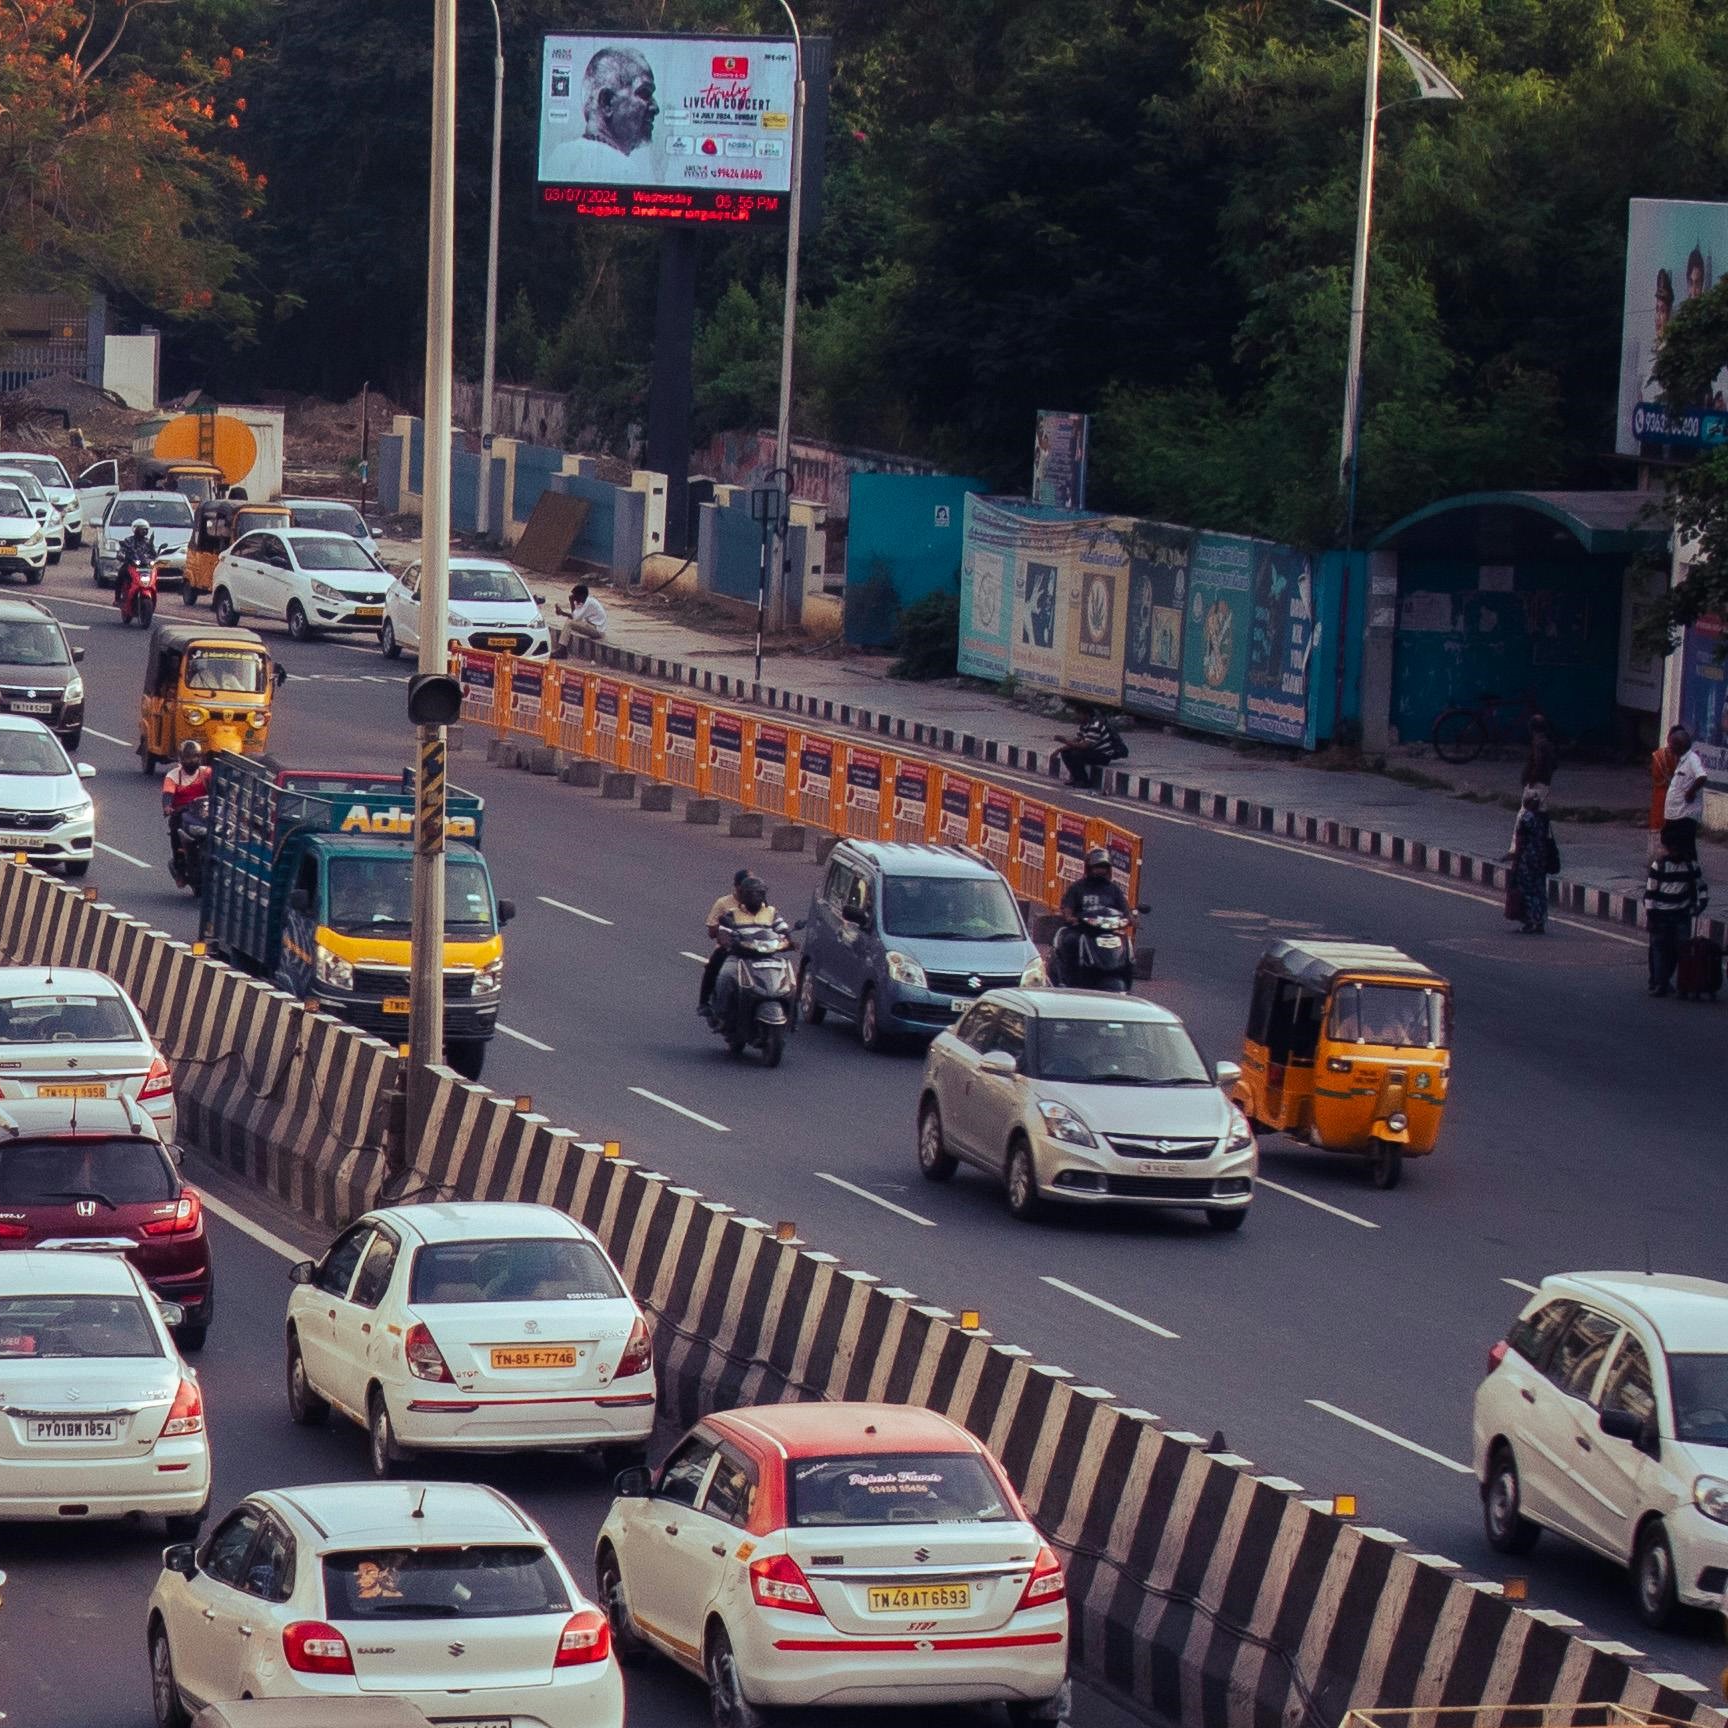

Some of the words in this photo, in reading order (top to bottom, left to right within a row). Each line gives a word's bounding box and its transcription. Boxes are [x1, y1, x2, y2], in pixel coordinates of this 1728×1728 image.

[683, 97, 709, 110] LIVE
[723, 98, 770, 111] CONCERT
[633, 191, 692, 206] Wednesday
[494, 1352, 530, 1365] TN-85
[534, 1352, 575, 1365] F-7746
